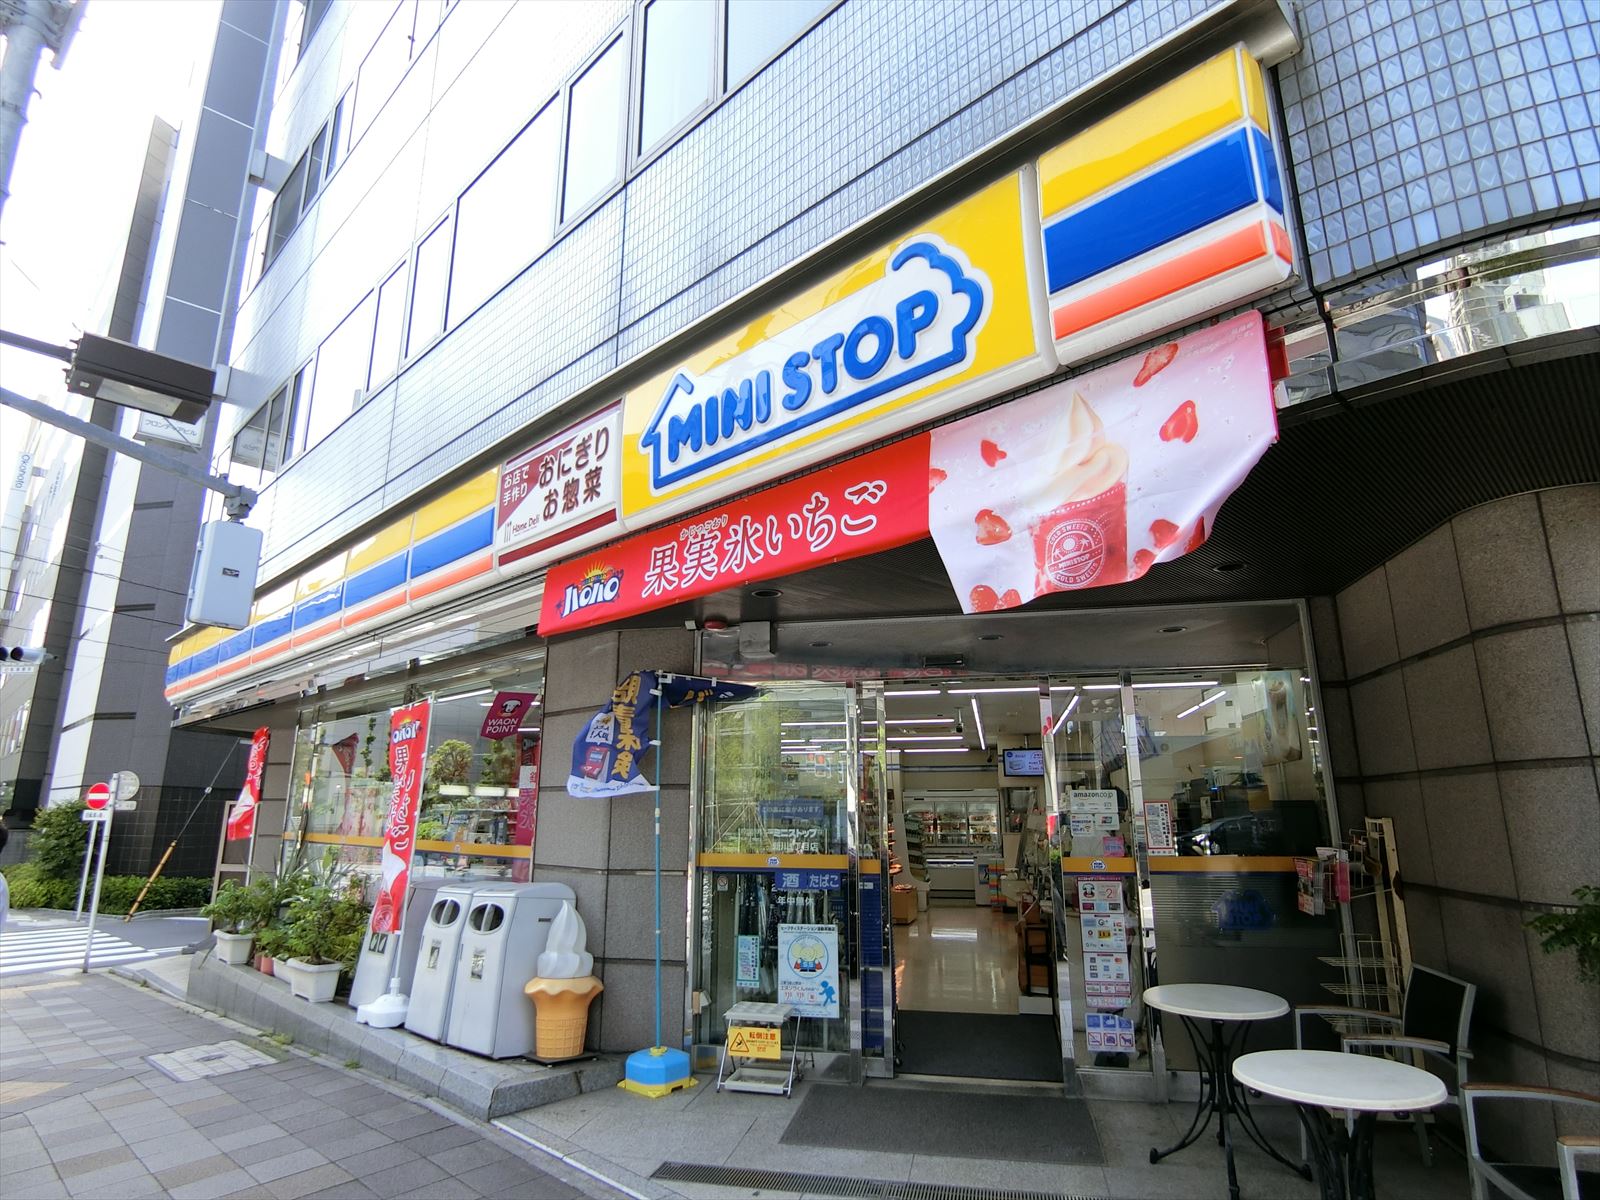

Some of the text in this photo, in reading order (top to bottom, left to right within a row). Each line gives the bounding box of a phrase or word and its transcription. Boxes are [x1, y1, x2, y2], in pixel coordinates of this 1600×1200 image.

[668, 289, 939, 463] MINI STOP
[539, 427, 610, 489] おにぎり
[505, 465, 530, 488] お店で
[503, 483, 528, 506] 手作り
[543, 466, 603, 522] お惣菜
[512, 521, 528, 533] Home
[528, 515, 540, 527] Deli
[1049, 523, 1089, 545] COLD SWEETS
[642, 480, 887, 598] 果実氷いちご
[1058, 553, 1090, 568] MINISTOP
[1056, 563, 1098, 583] COLD SWEETS
[486, 725, 517, 734] POINT
[488, 717, 519, 726] WAON
[782, 873, 800, 888] 酒
[809, 873, 840, 888] たばこ
